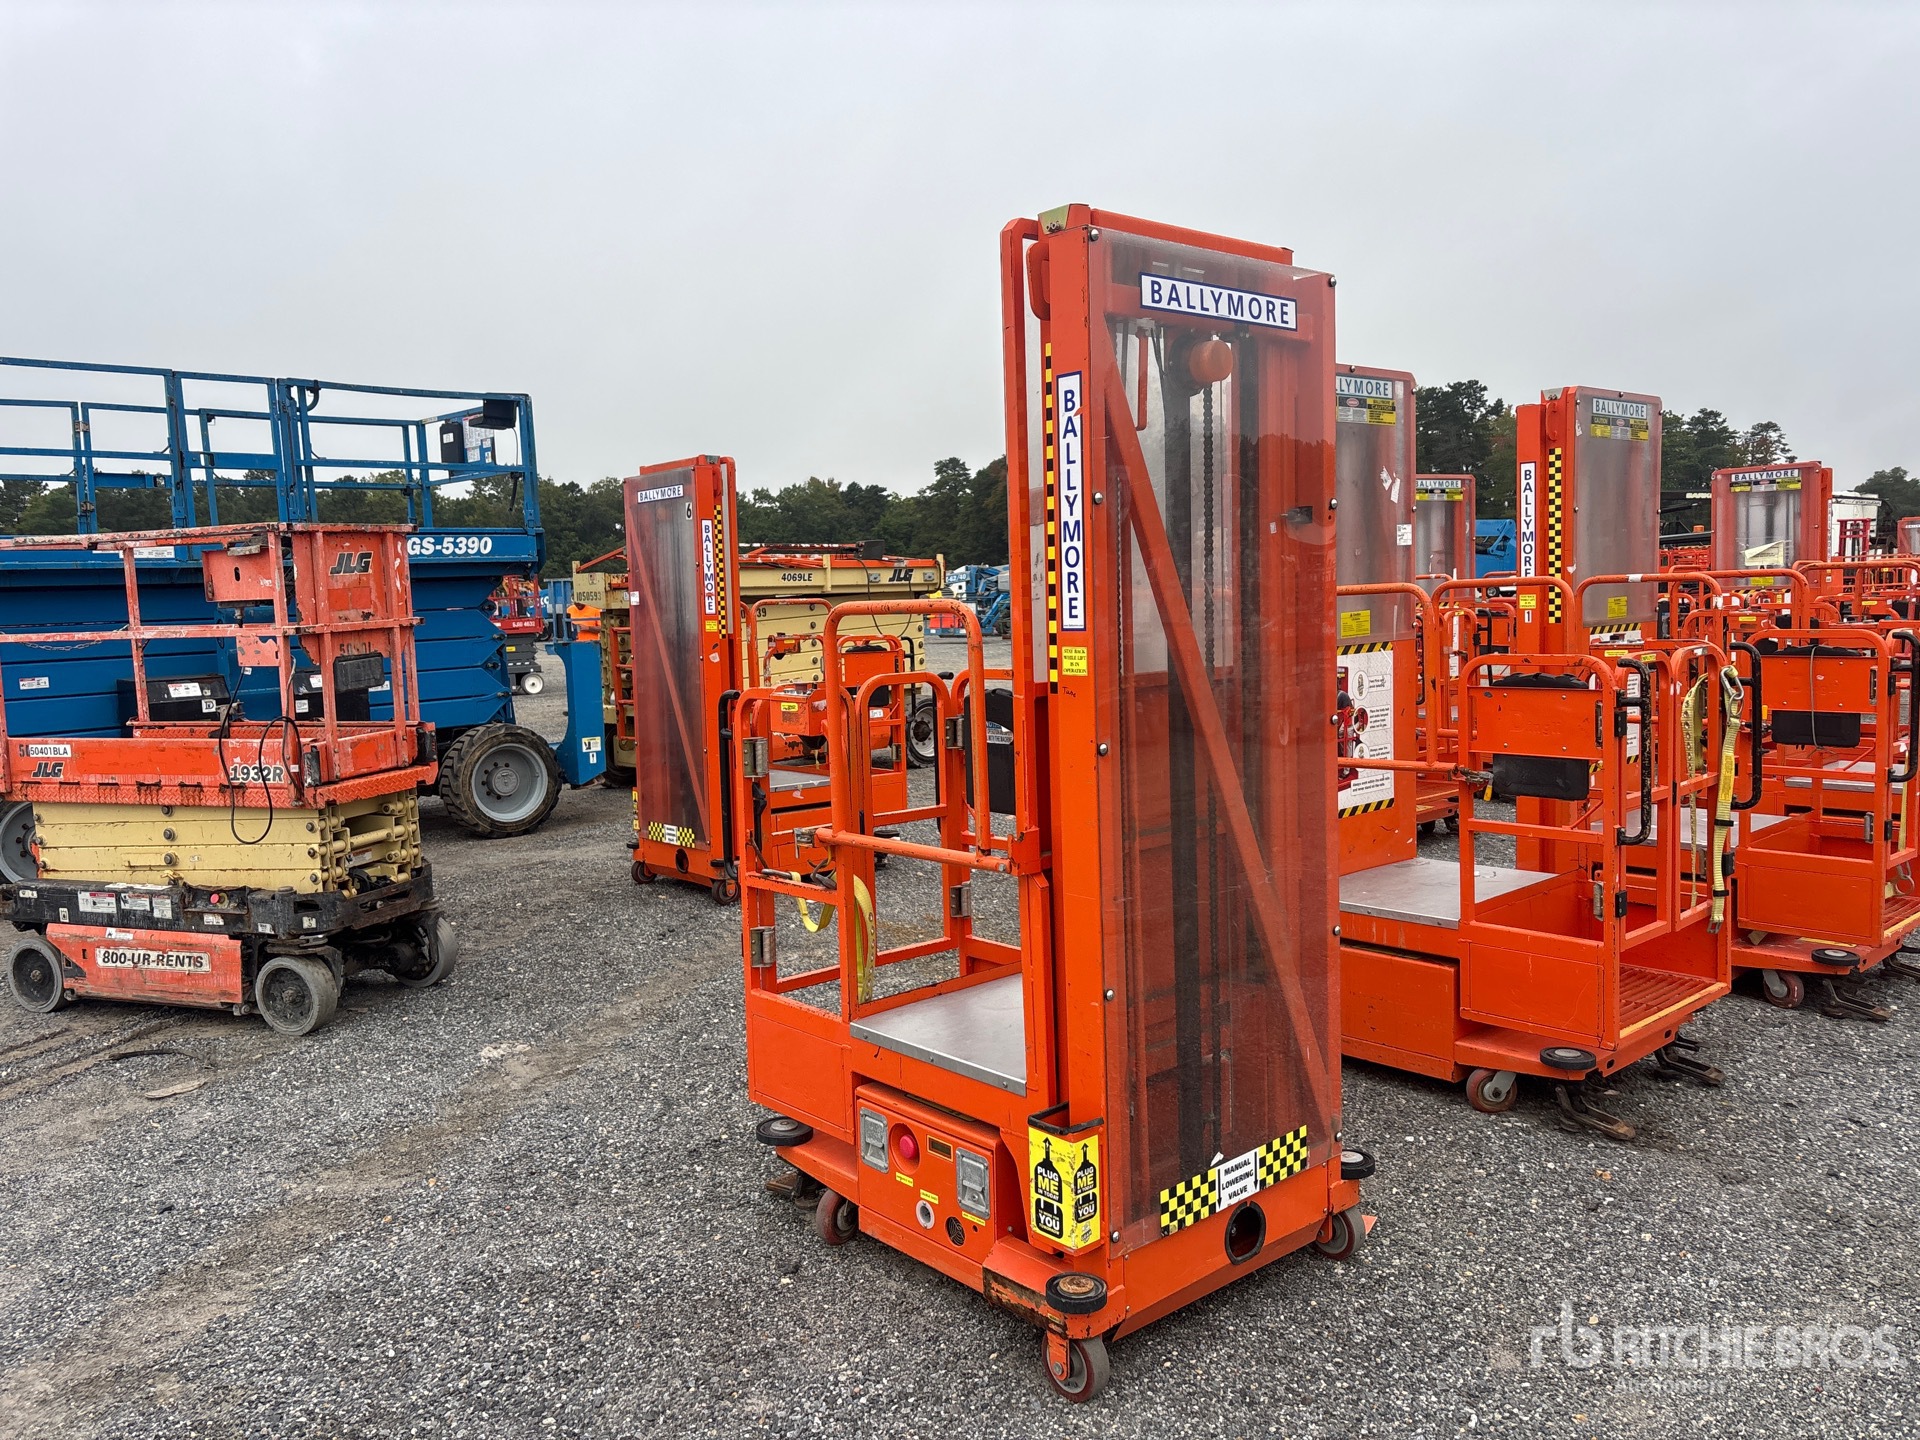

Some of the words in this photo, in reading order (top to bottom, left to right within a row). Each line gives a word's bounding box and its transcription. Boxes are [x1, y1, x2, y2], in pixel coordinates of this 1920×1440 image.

[1150, 279, 1290, 325] BALLYMORE
[1595, 400, 1645, 417] BALLYMORE
[1734, 470, 1795, 481] BALLYMORE
[640, 486, 682, 502] BALLYMORE
[686, 503, 692, 519] 6
[1063, 389, 1081, 619] BALLYMORE
[1522, 469, 1534, 577] BALLYMORE
[406, 537, 493, 556] GS-5390
[329, 552, 373, 575] JLG
[781, 573, 813, 582] 4069LE
[888, 569, 914, 582] JLG
[576, 591, 602, 602] 1050593
[1526, 611, 1531, 622] 1
[30, 746, 69, 756] 50401BLA
[32, 763, 64, 777] JLG
[230, 766, 285, 782] 1932R
[102, 950, 204, 968] 800-UR-RENTS
[1037, 1165, 1059, 1181] PLUG
[1076, 1166, 1094, 1179] PLUG
[1224, 1158, 1251, 1176] MANUAL
[1038, 1175, 1059, 1196] ME
[1077, 1173, 1094, 1189] ME
[1222, 1169, 1254, 1190] LOWERING
[1043, 1189, 1059, 1201] TODAY
[1082, 1184, 1094, 1192] TODAY
[1228, 1185, 1248, 1200] VALVE
[1078, 1203, 1095, 1217] YOU
[1039, 1213, 1060, 1231] YOU
